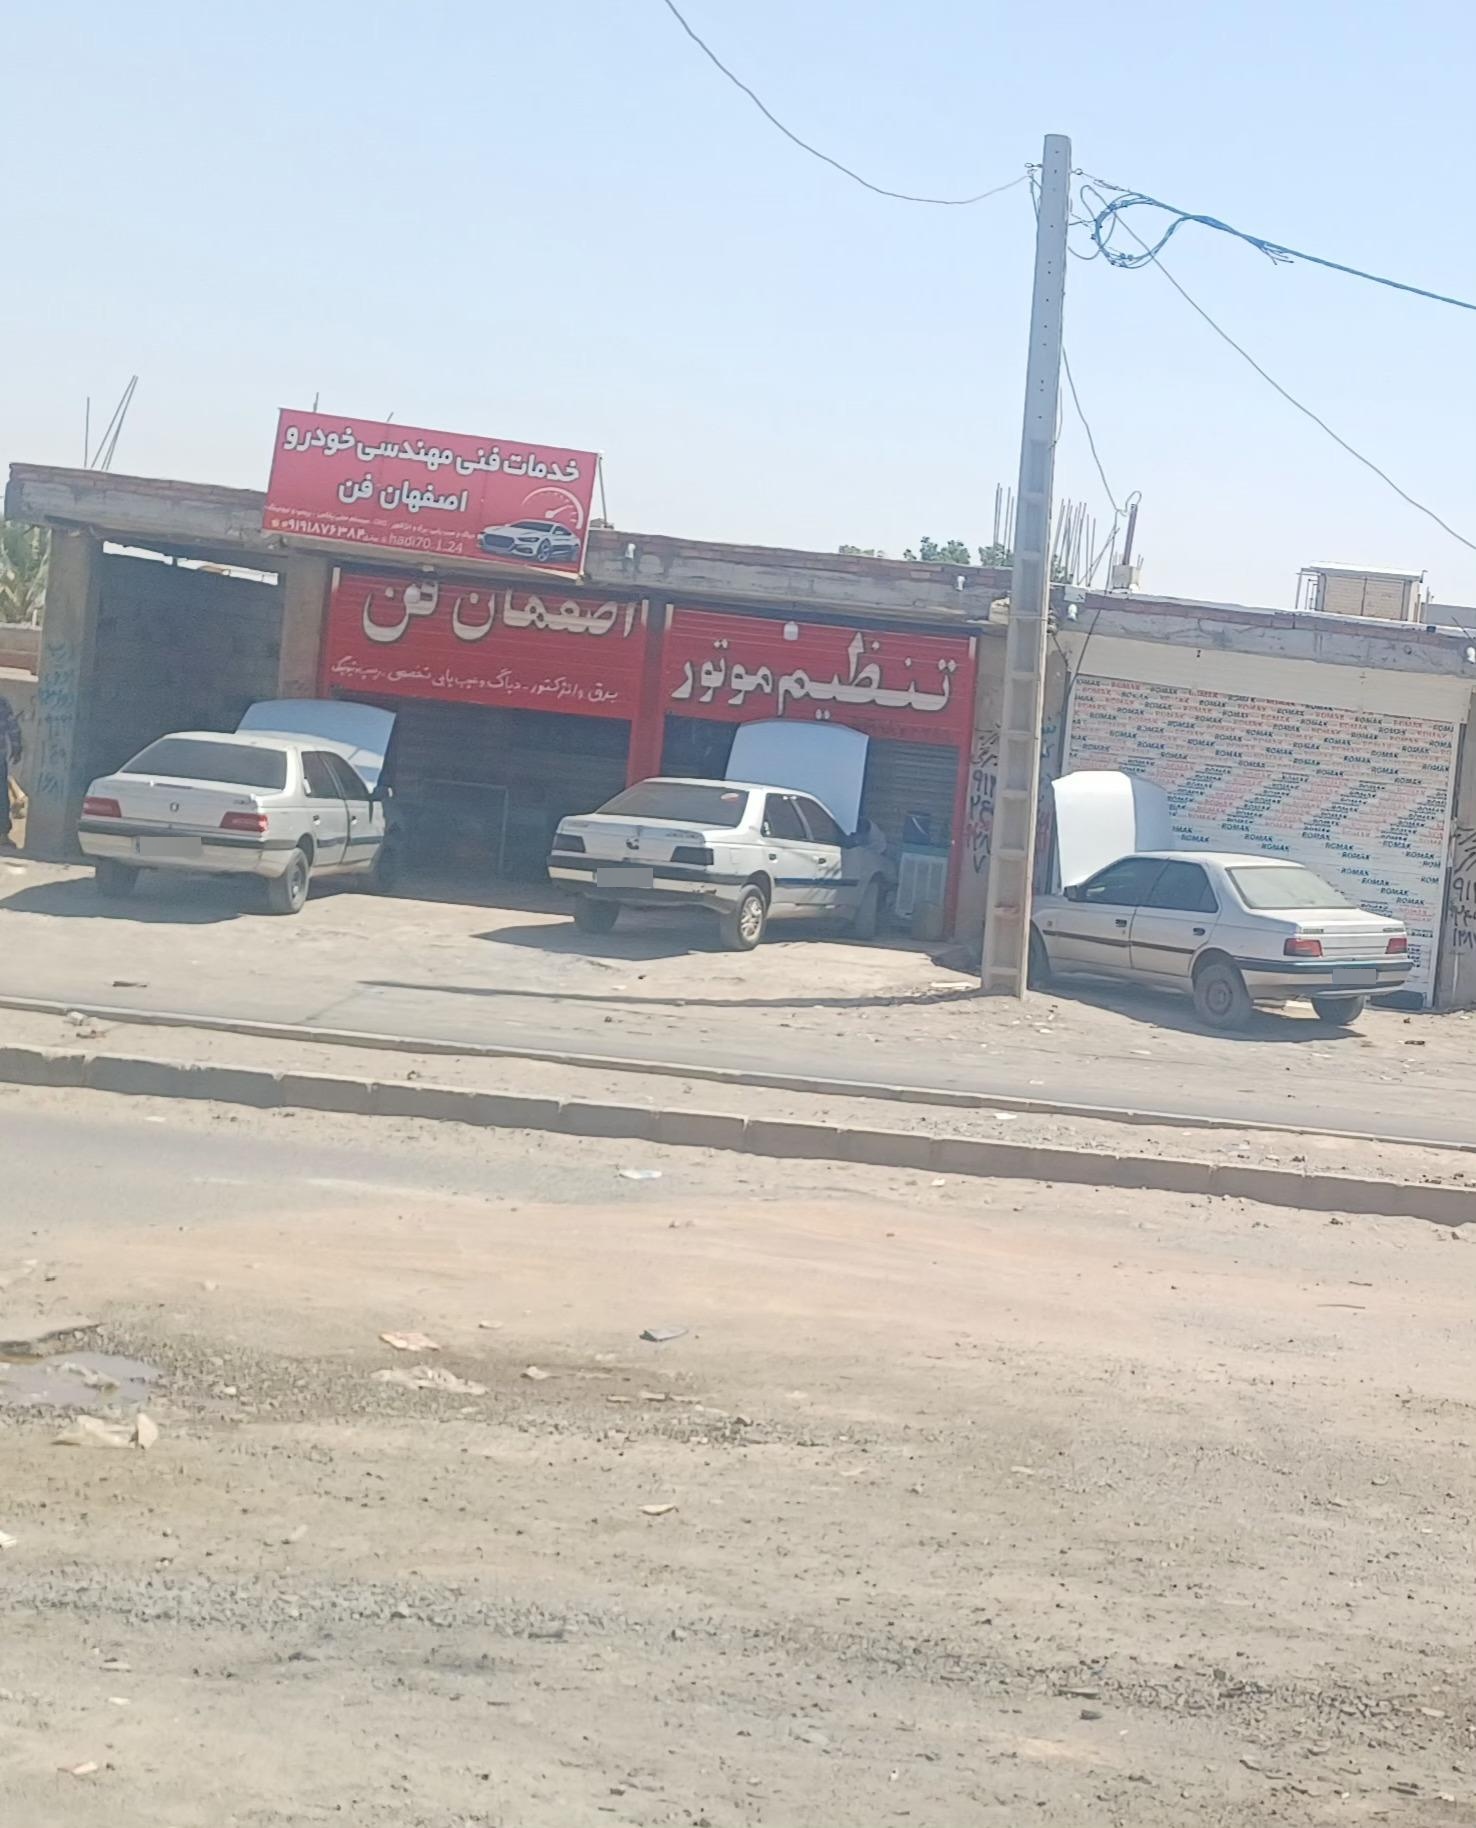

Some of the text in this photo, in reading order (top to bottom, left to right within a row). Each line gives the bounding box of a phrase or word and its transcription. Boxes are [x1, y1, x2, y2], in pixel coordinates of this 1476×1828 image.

[284, 427, 579, 482] خدمات فنی مهندسی خودرو
[338, 473, 468, 513] اصفهان فن
[363, 580, 634, 642] اصفهان فن
[671, 632, 956, 720] تنظیم موتور
